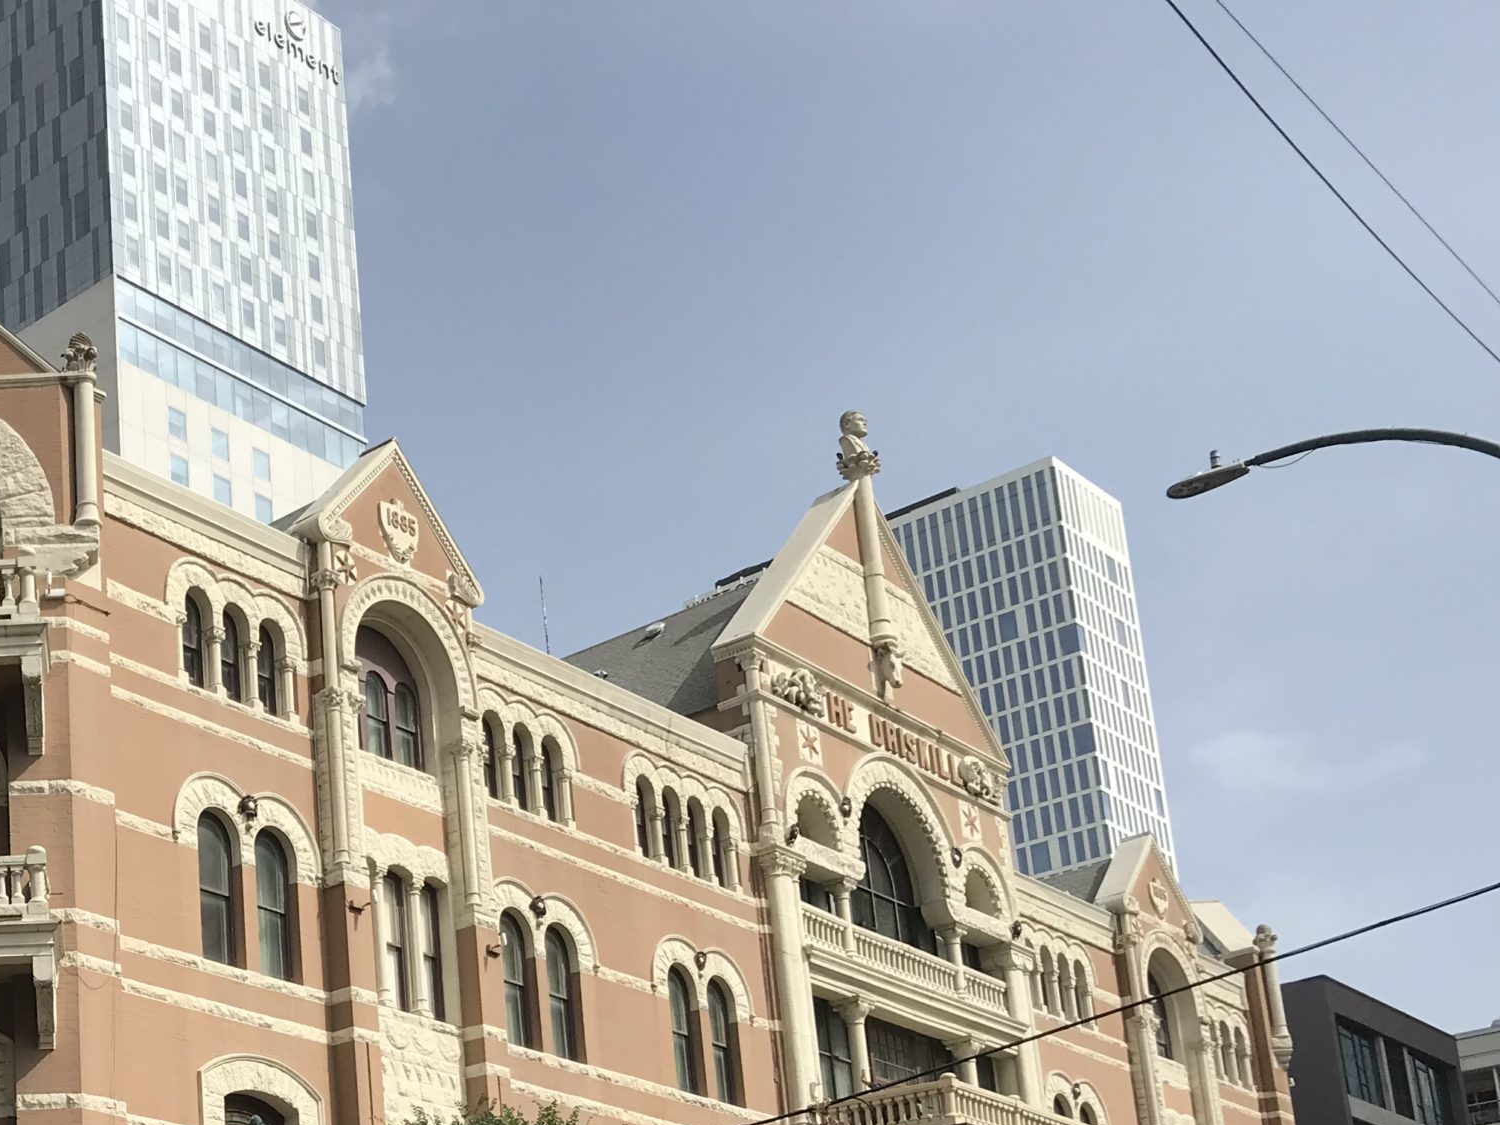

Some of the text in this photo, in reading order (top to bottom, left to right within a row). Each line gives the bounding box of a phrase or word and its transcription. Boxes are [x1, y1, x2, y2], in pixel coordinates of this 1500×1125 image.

[254, 21, 340, 86] element
[386, 508, 416, 537] 1885
[868, 713, 964, 788] DRISKILL
